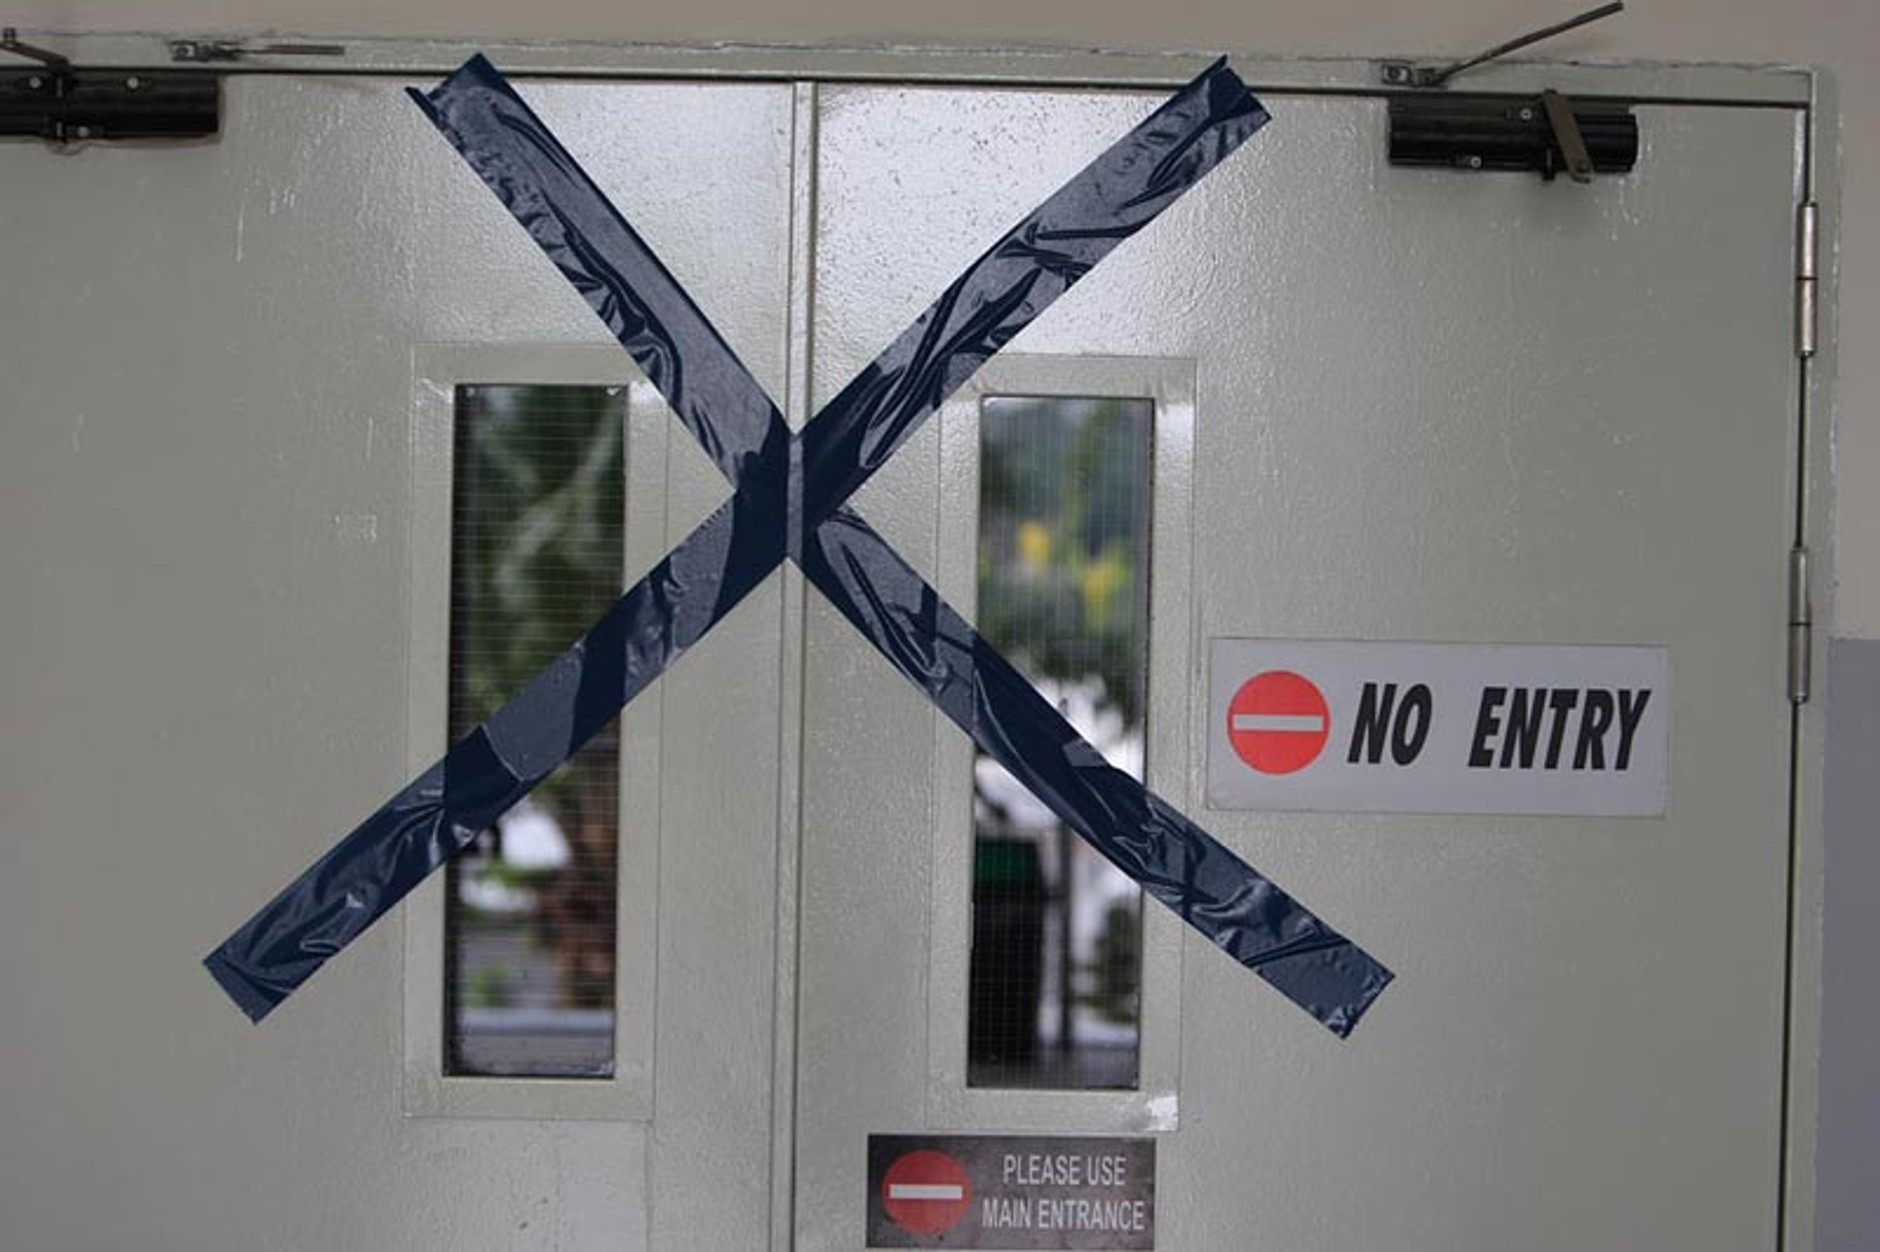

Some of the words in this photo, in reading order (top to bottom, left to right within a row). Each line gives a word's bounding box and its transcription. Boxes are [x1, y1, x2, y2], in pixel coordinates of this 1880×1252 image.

[1347, 682, 1432, 766] NO
[1468, 686, 1652, 771] ENTRY
[1003, 1155, 1080, 1185] PLEASE
[1086, 1156, 1127, 1186] USE
[982, 1198, 1031, 1229] MAIN
[1037, 1200, 1144, 1230] ENTRANCE
